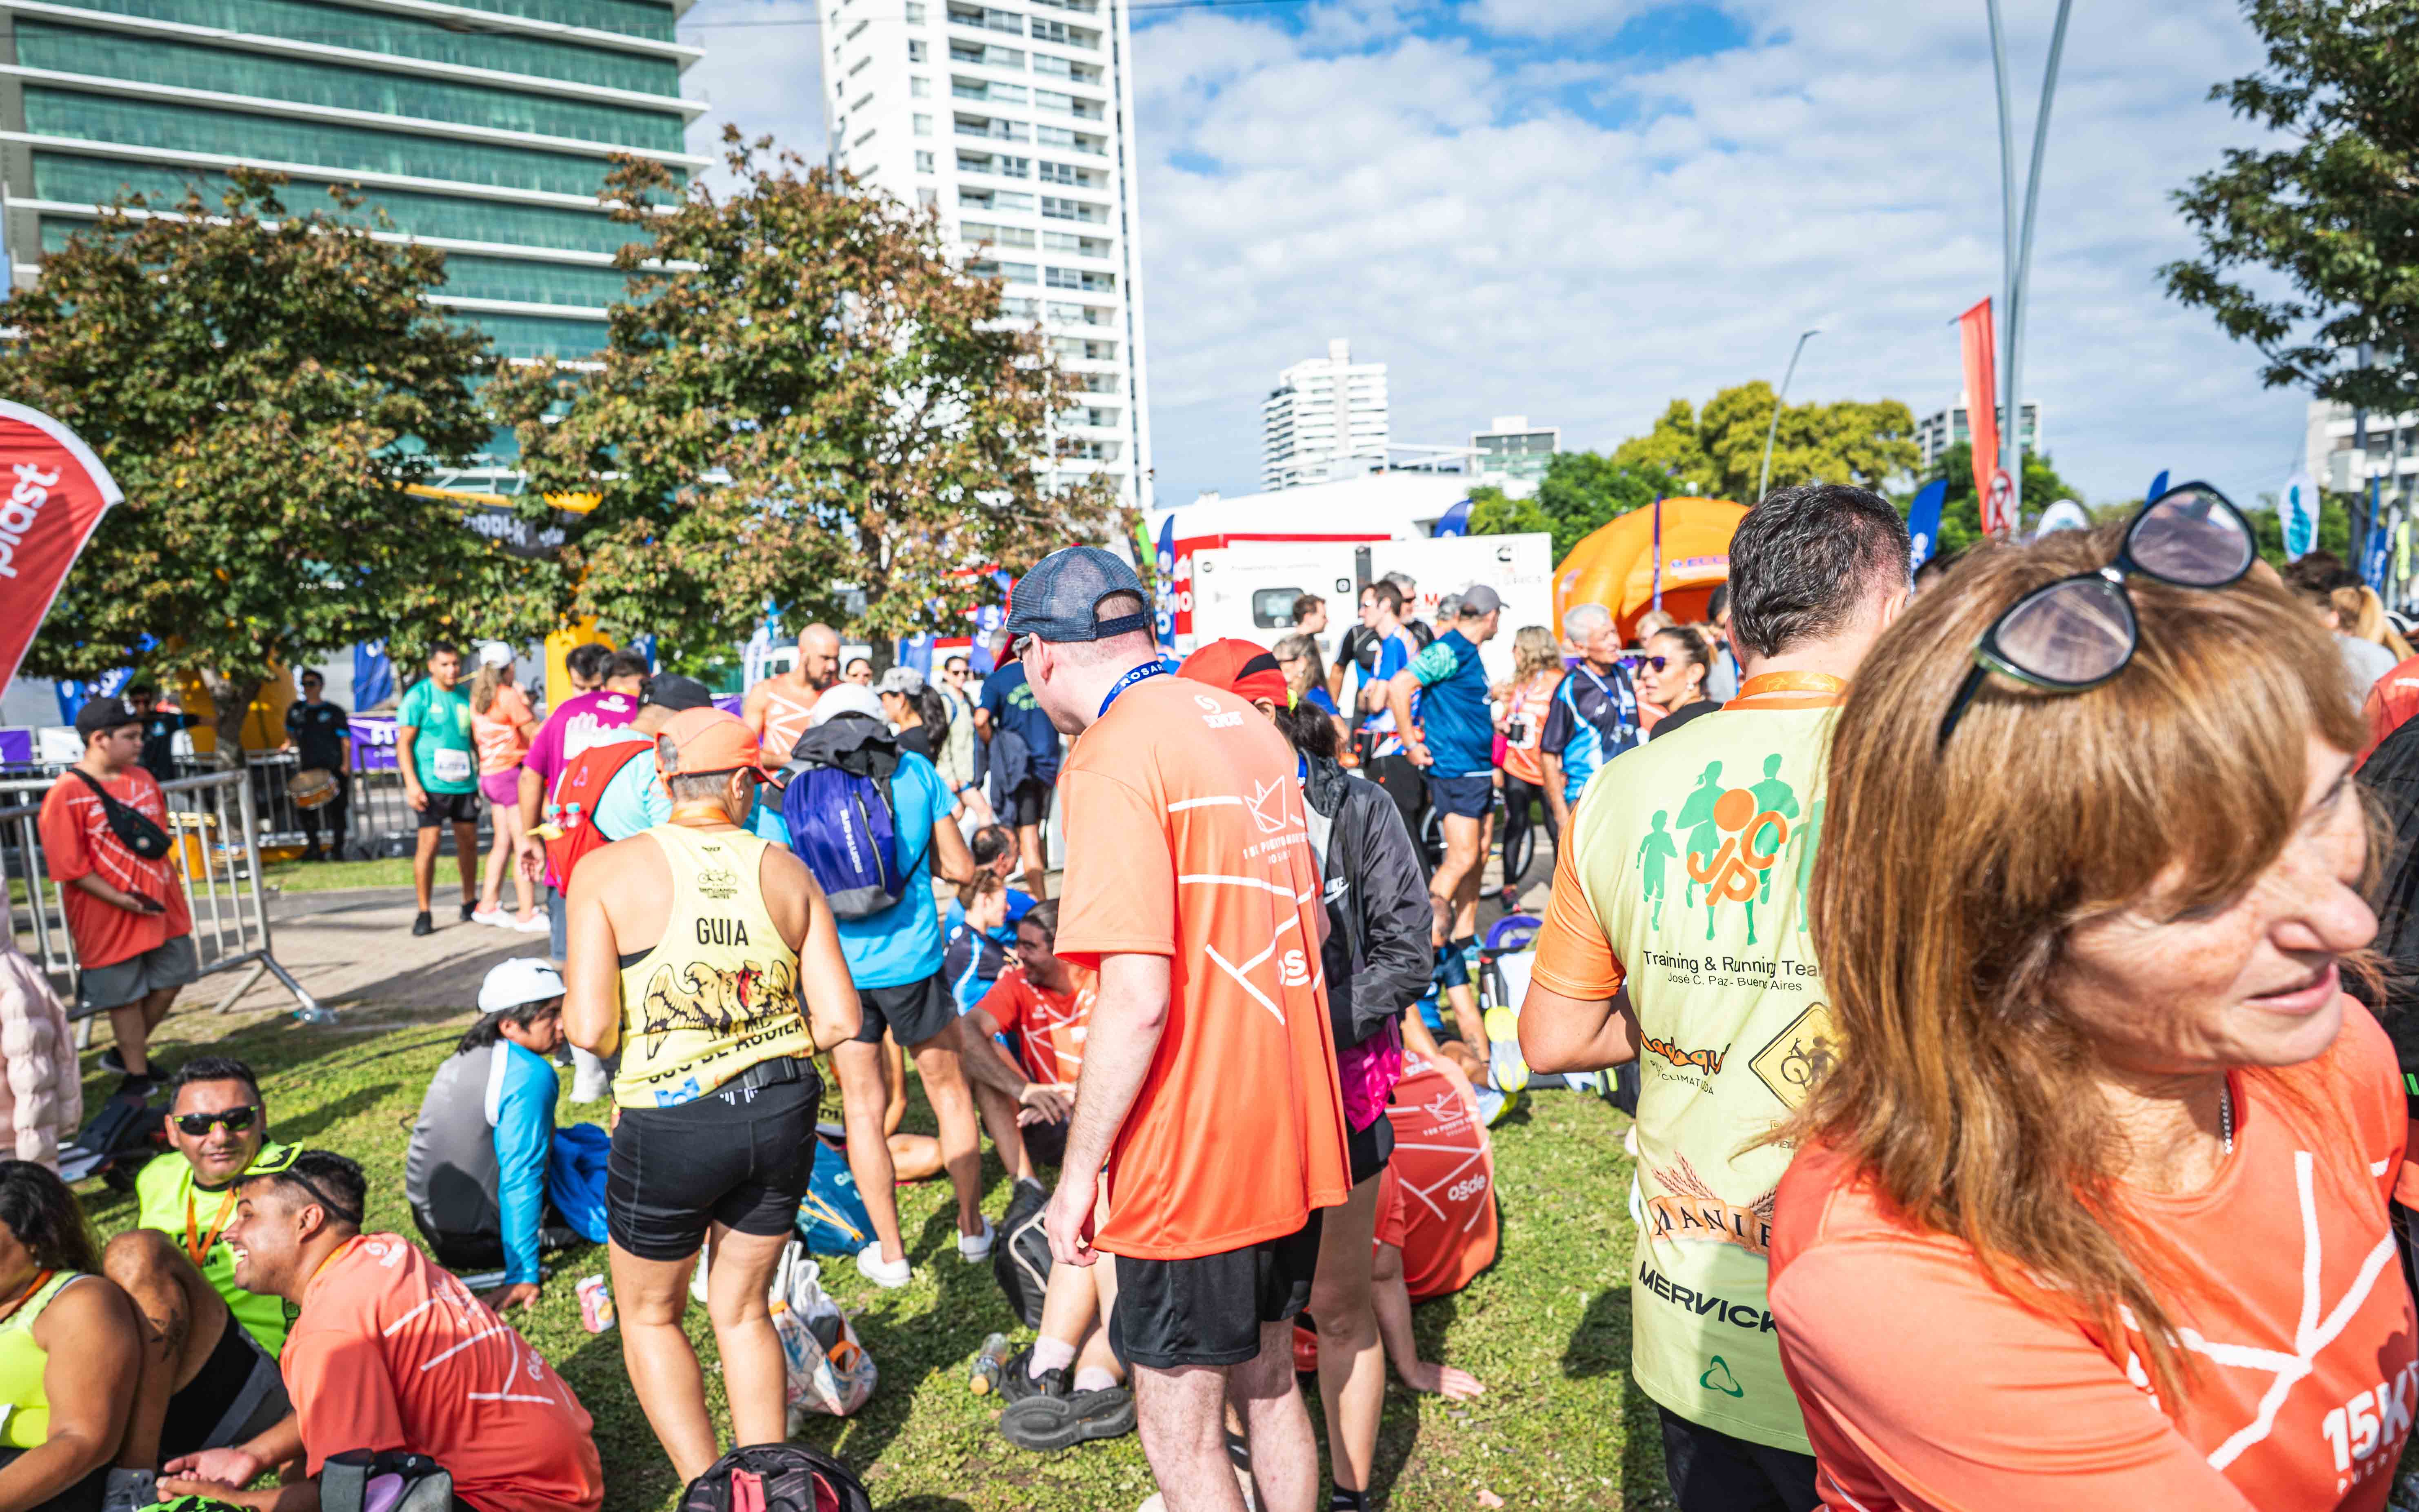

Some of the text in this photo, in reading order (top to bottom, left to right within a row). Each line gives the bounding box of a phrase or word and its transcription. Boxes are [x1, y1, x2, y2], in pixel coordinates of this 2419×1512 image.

[696, 917, 749, 946] GUIA
[1643, 950, 1698, 974] Training
[1704, 956, 1717, 971] &
[1781, 960, 1821, 977] Tea
[1668, 972, 1690, 984] José
[1693, 975, 1704, 985] C.
[1770, 980, 1802, 991] Aires
